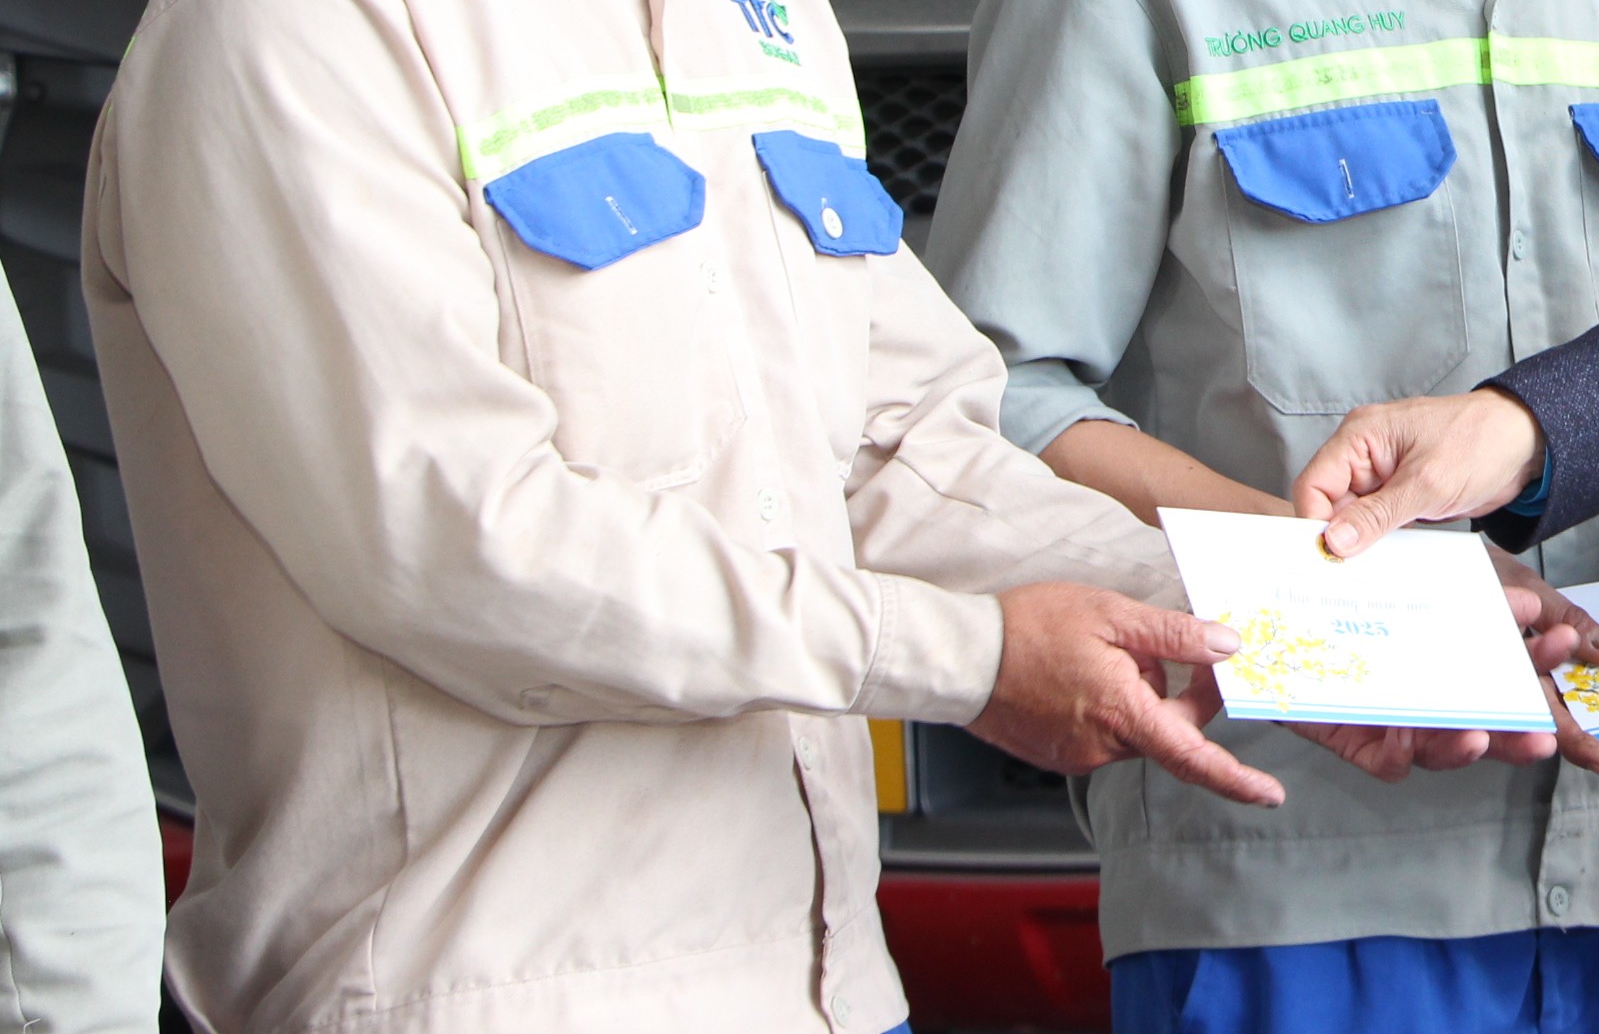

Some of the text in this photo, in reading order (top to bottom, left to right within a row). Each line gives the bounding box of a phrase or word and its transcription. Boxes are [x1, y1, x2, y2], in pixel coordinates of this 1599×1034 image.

[1288, 14, 1366, 44] QUANG
[1367, 10, 1406, 32] HUY
[1330, 617, 1391, 638] 2025
